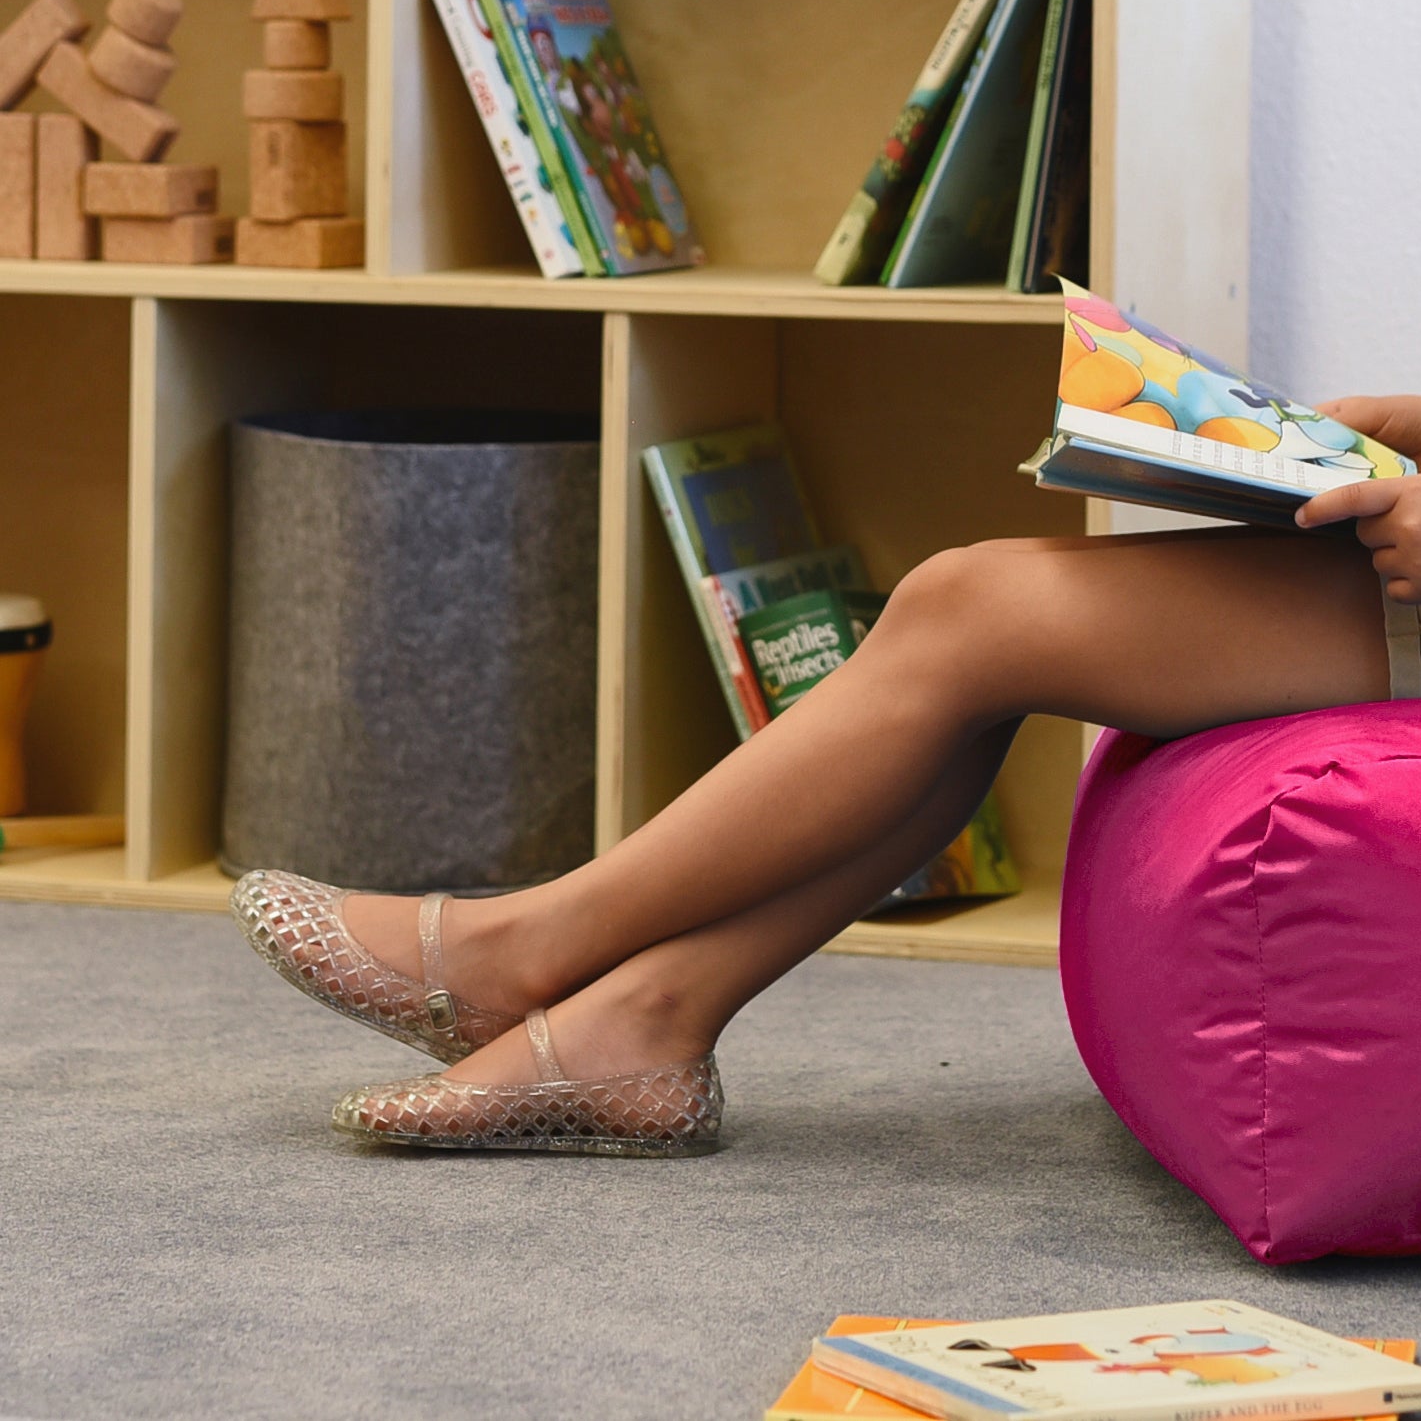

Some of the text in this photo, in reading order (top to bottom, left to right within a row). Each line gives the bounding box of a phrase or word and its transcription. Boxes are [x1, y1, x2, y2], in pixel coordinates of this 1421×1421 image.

[752, 622, 840, 667] Reptiles
[774, 649, 846, 687] Insects
[1228, 1405, 1258, 1419] AND
[1263, 1402, 1290, 1416] THE
[1292, 1400, 1324, 1413] EGG
